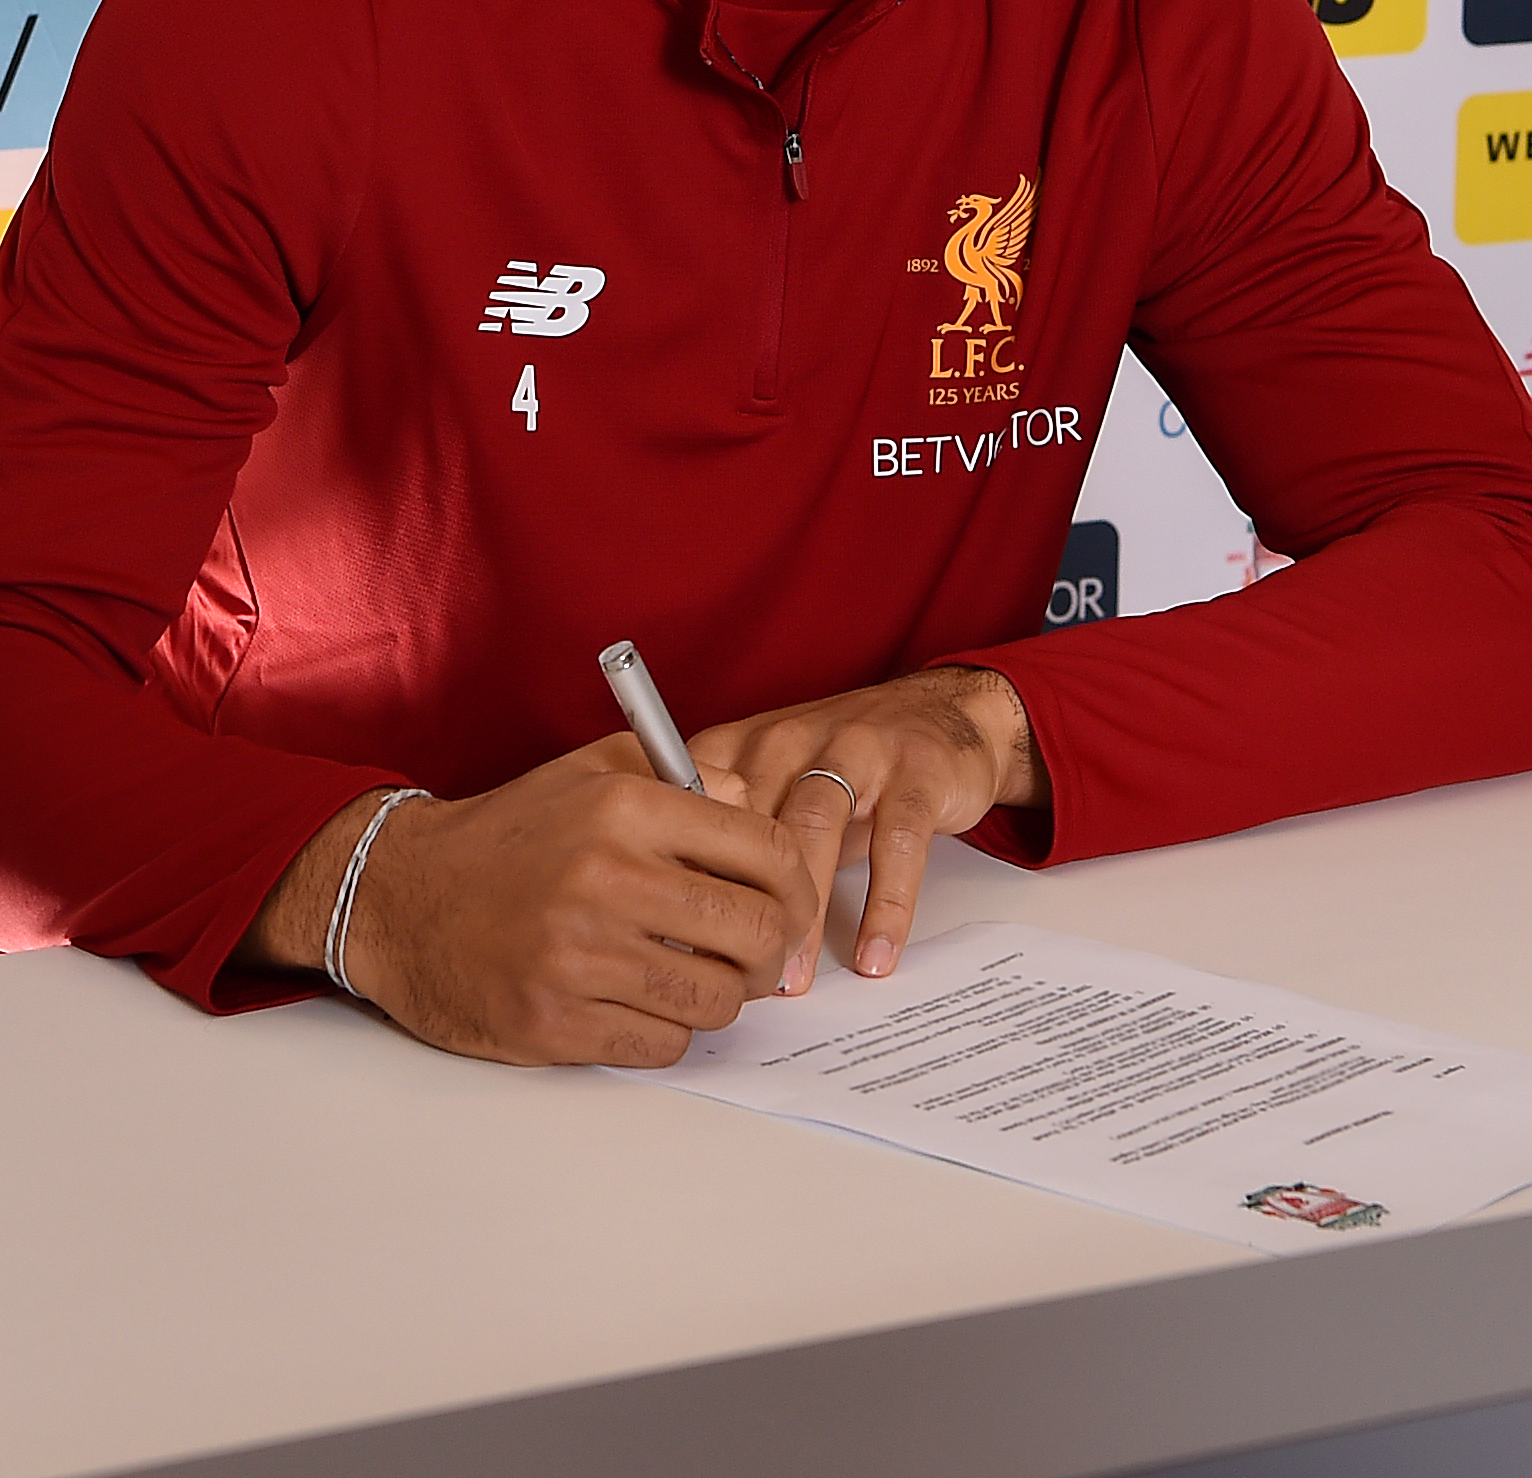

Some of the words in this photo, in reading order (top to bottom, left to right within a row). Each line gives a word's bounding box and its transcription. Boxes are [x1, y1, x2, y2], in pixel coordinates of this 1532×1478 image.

[906, 258, 939, 273] 1892
[511, 364, 539, 431] 4
[928, 388, 958, 405] 125
[963, 382, 1020, 404] YEARS
